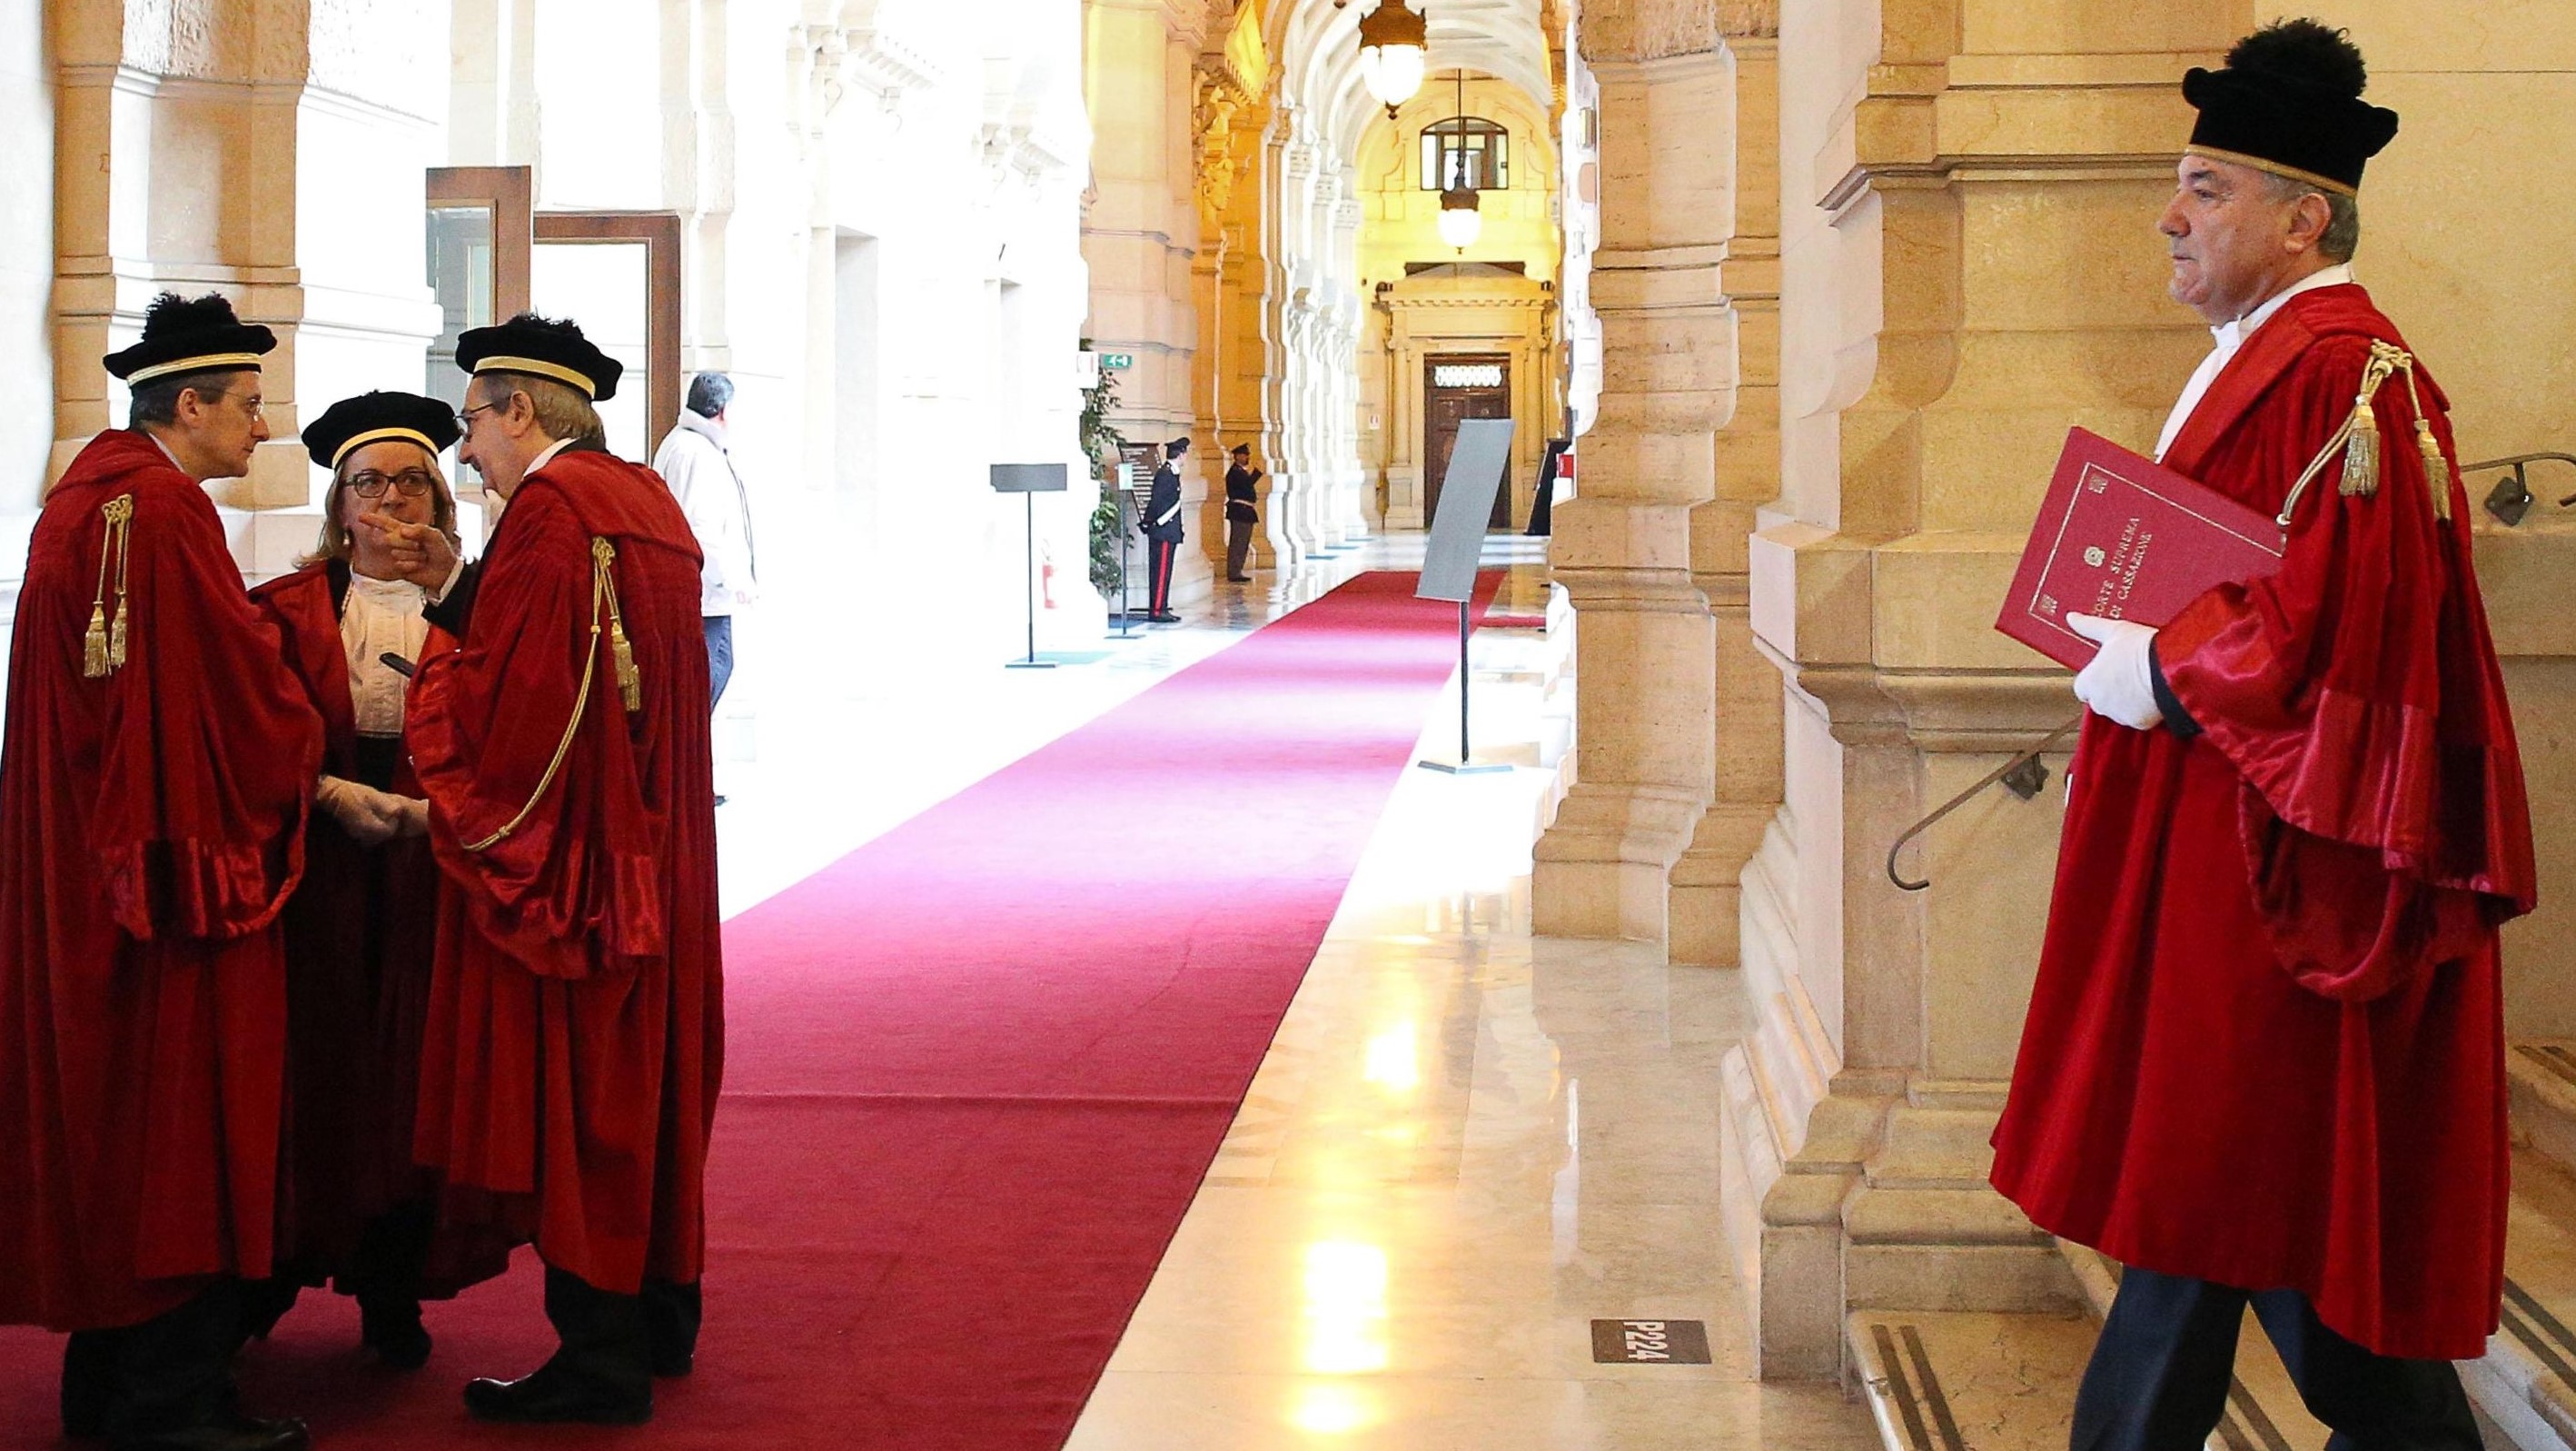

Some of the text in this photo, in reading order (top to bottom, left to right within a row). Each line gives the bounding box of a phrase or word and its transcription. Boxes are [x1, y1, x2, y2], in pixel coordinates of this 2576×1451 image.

[2110, 518, 2140, 573] SUPREMA
[2109, 533, 2152, 619] DI CASSAZIONE
[1623, 1321, 1670, 1360] P224
